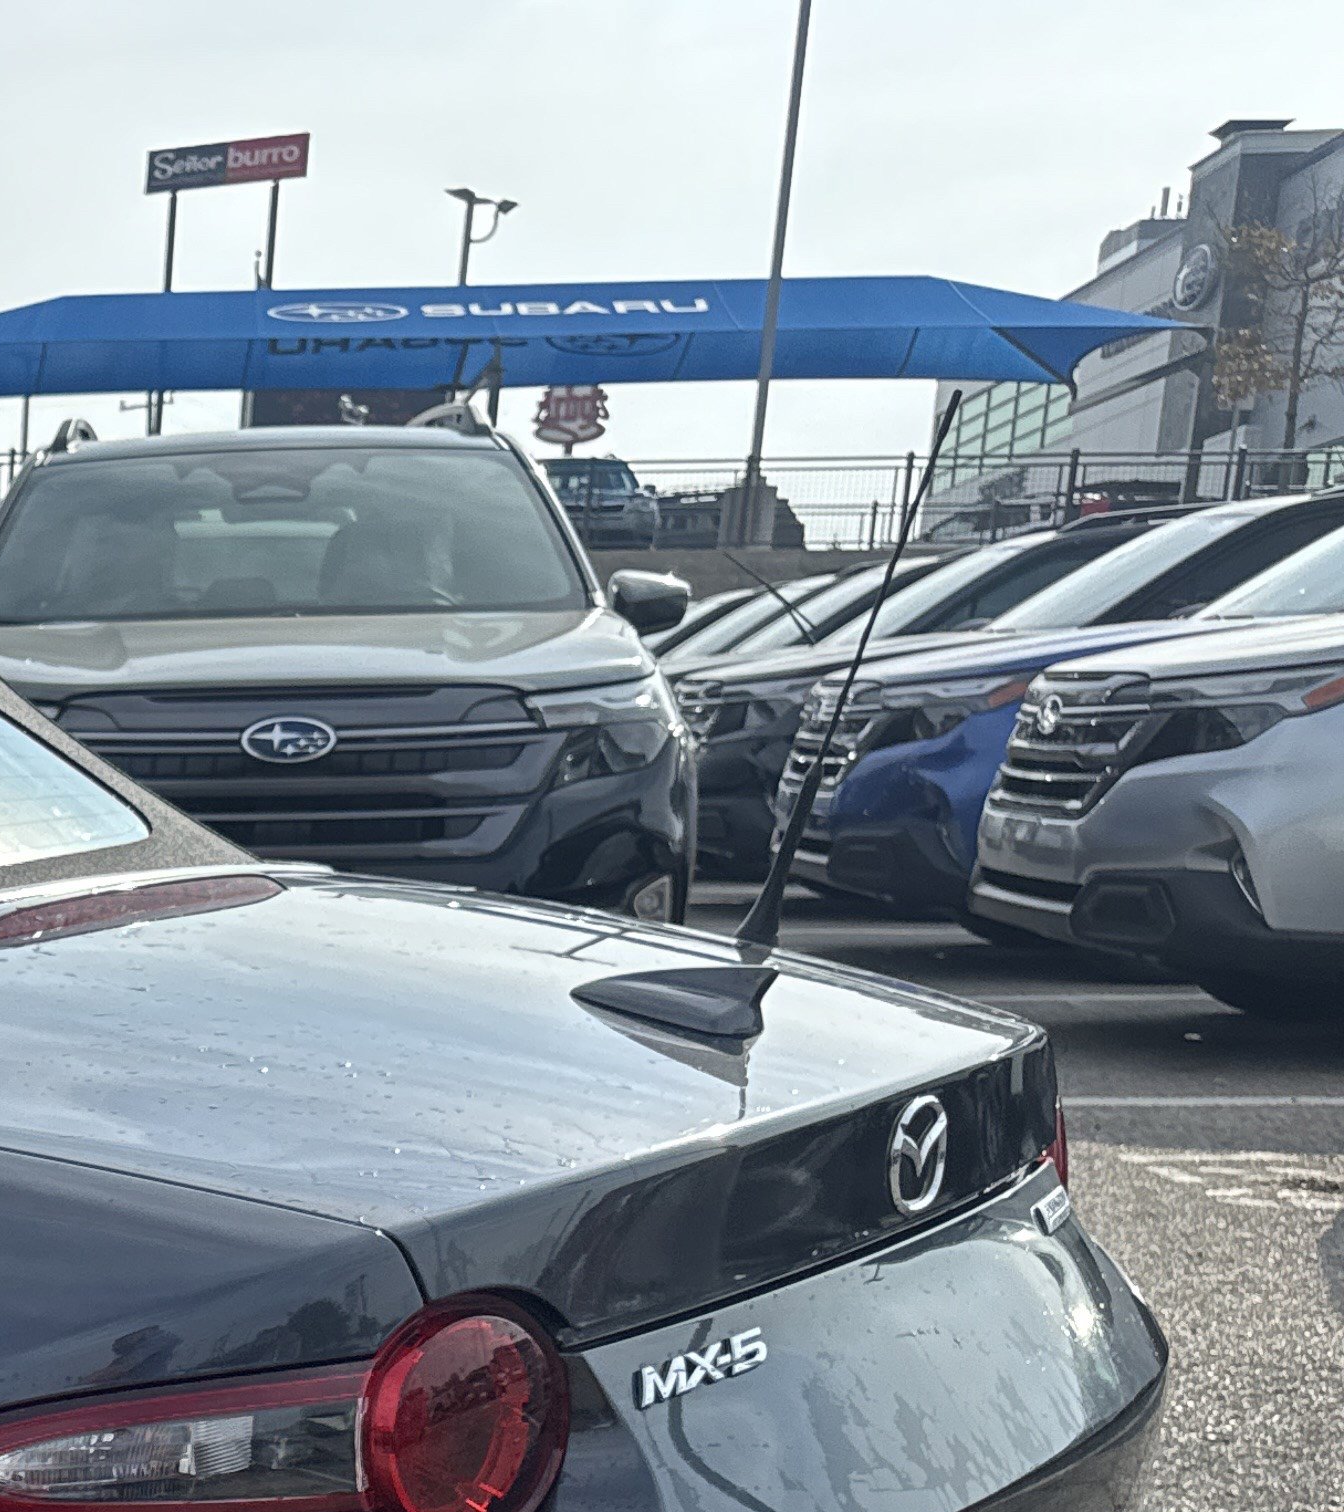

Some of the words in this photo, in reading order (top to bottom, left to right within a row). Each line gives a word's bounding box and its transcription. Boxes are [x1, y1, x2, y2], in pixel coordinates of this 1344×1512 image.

[227, 144, 301, 169] burro
[420, 298, 710, 317] SUBARU
[636, 1326, 768, 1409] MX-5
